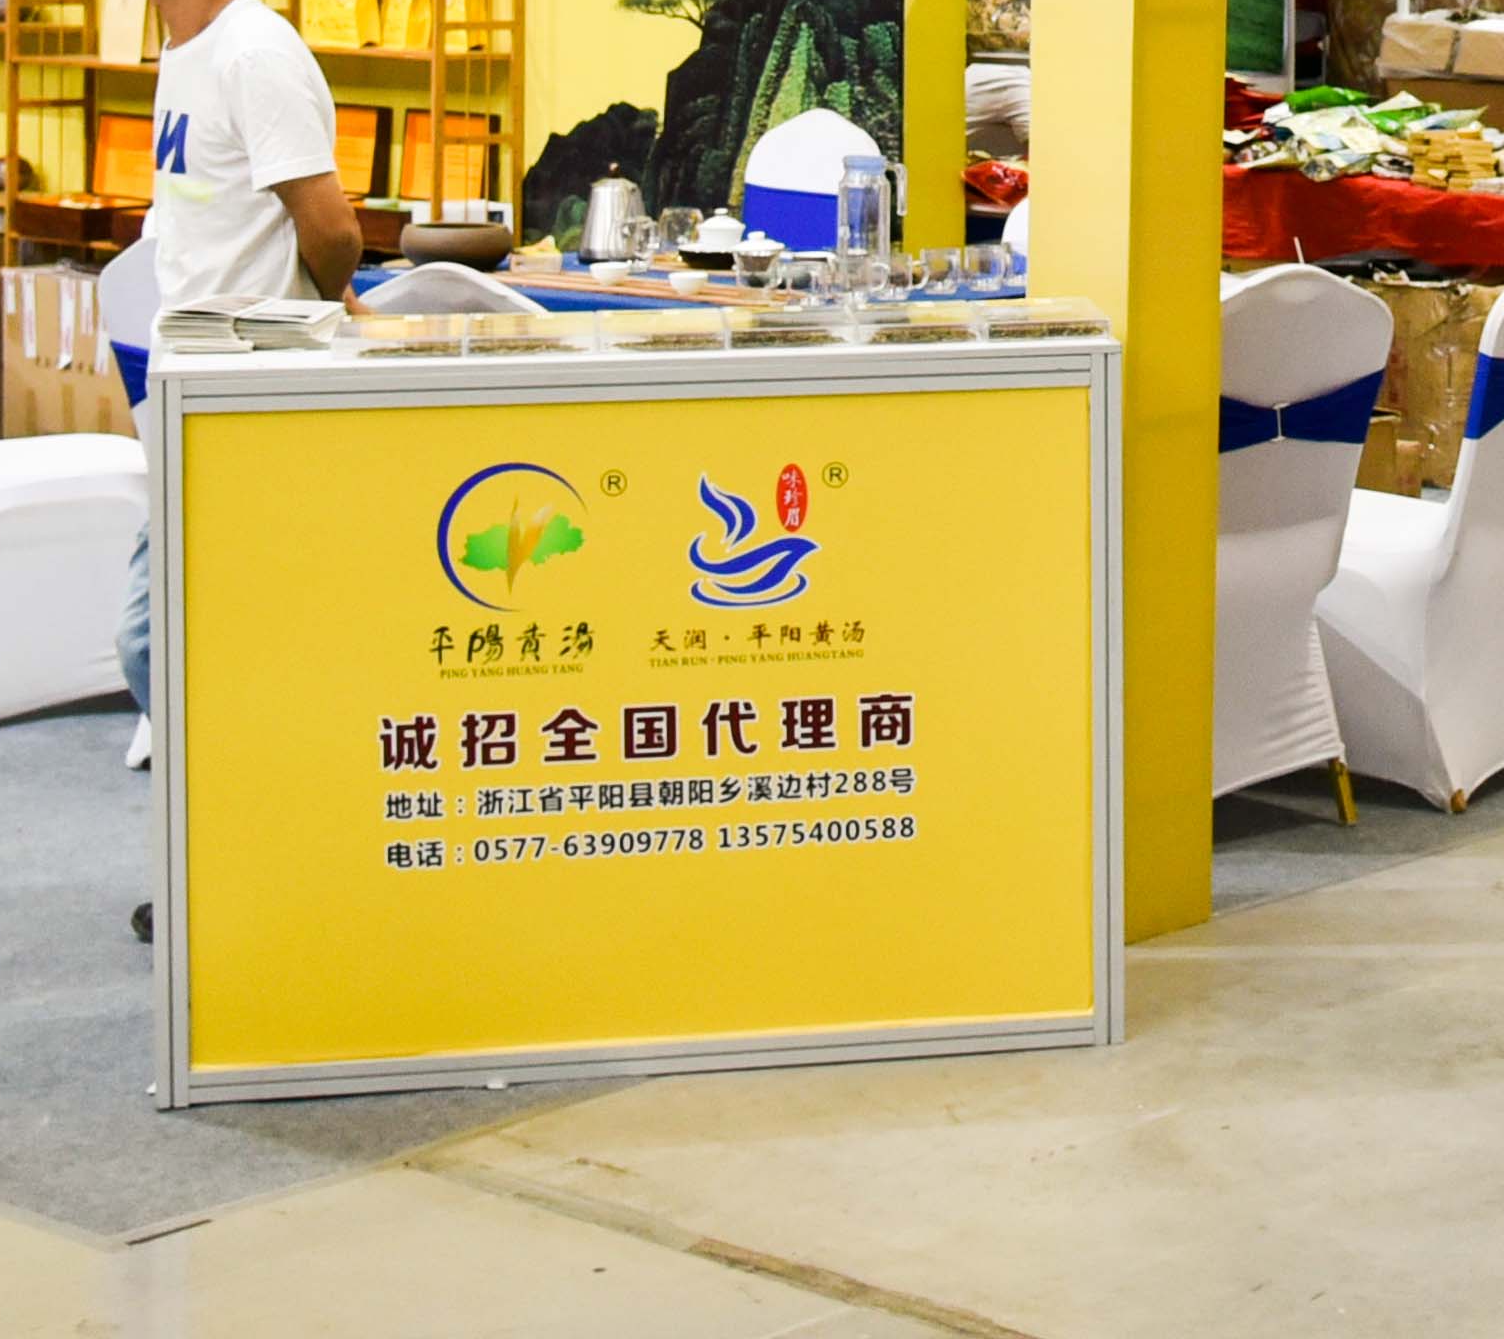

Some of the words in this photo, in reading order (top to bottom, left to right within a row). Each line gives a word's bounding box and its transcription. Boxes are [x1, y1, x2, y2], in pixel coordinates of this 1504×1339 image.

[380, 693, 916, 772] 诚招全国代理商
[385, 768, 916, 820] 地址：浙江省平阳县朝阳乡溪边村288号
[386, 828, 706, 869] 电话：0577-63909778
[716, 816, 917, 851] 13575400588
